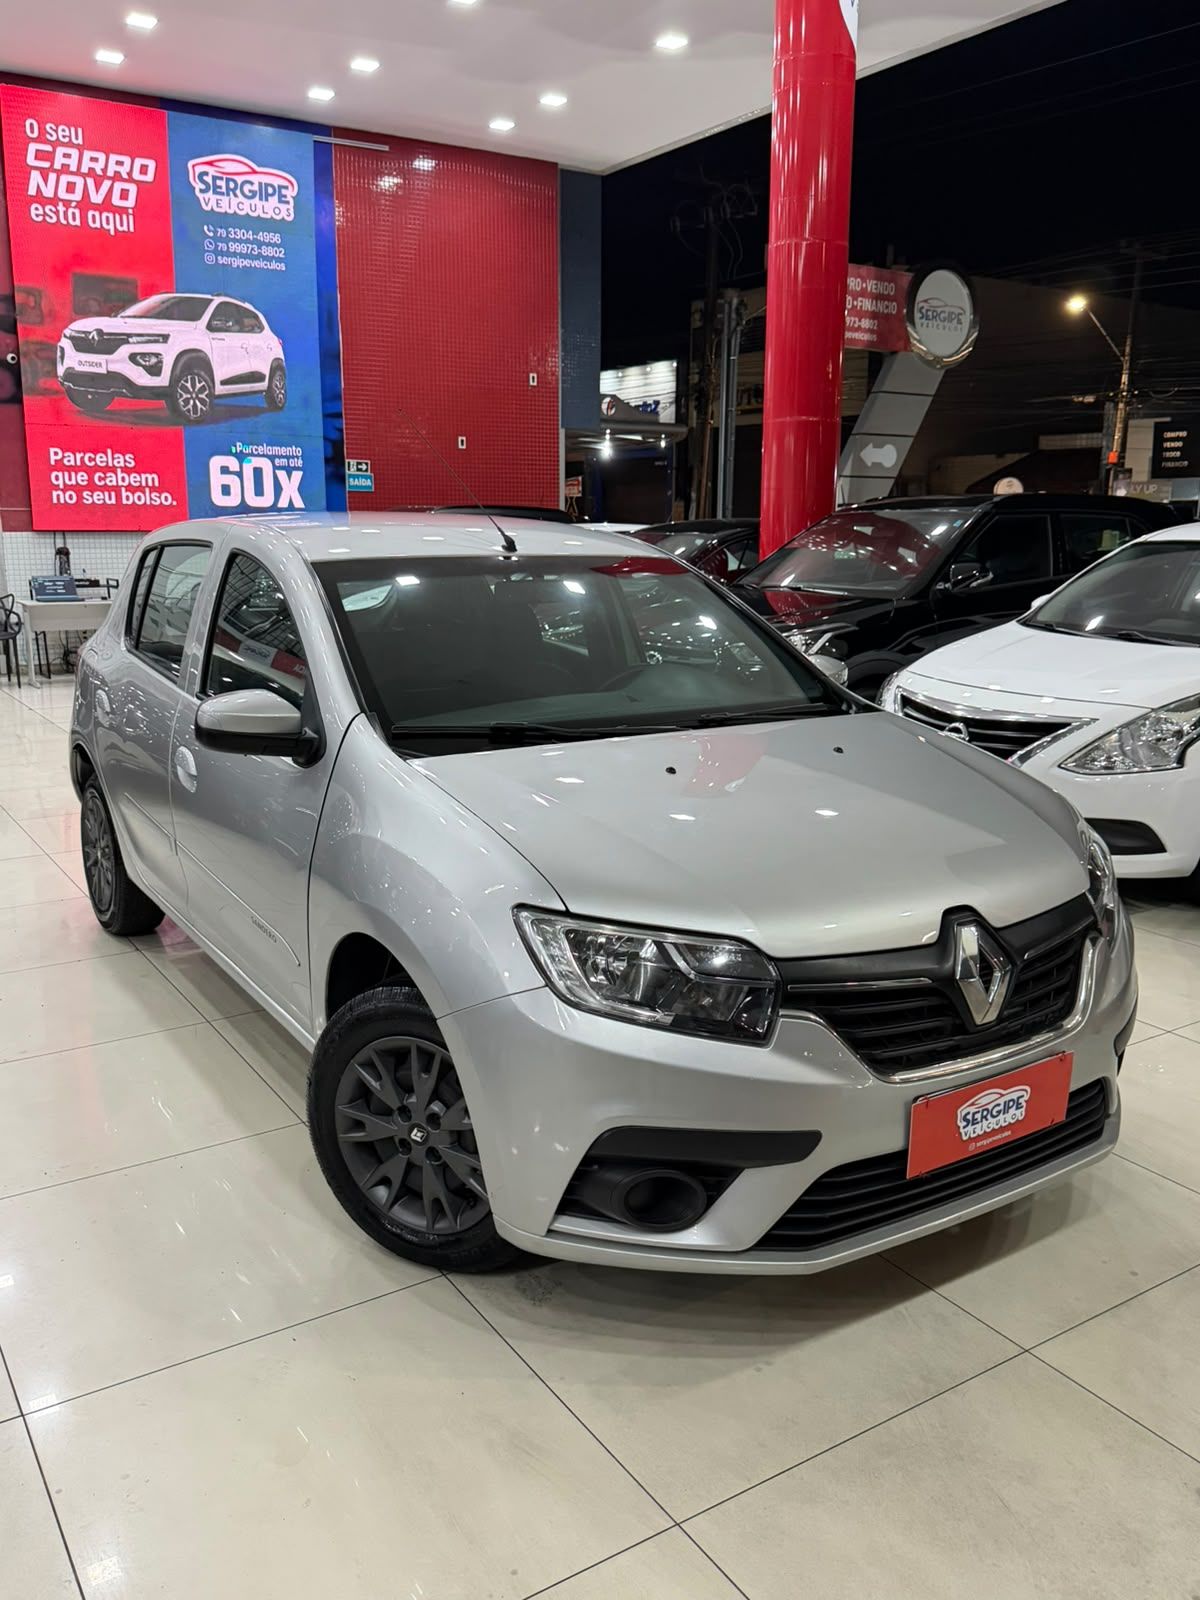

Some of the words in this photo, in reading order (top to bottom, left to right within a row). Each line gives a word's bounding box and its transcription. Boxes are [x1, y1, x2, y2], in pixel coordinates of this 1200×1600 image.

[45, 122, 83, 145] seu
[26, 142, 156, 182] CARRO
[27, 169, 138, 208] NOVO
[197, 171, 290, 205] SERGIPE
[30, 201, 80, 226] está
[87, 208, 135, 236] aqui
[217, 228, 227, 237] 79
[228, 228, 282, 244] 3304-4956
[217, 242, 227, 251] 79
[228, 242, 285, 258] 99973-8802
[217, 255, 286, 271] sergipeveiculos
[866, 280, 895, 296] VENDO
[857, 297, 897, 315] FINANCIO
[919, 306, 963, 325] SERGIPE
[49, 447, 135, 467] Parcelas
[236, 441, 302, 456] Parcelamento
[275, 458, 288, 467] em
[289, 456, 303, 467] até
[50, 470, 88, 489] que
[94, 468, 159, 487] cabem
[209, 455, 305, 509] 60x
[349, 477, 372, 487] SAÍDA
[52, 489, 77, 504] no
[82, 489, 116, 504] seu
[121, 487, 177, 506] bolso.
[963, 1095, 1025, 1130] SERGIPE
